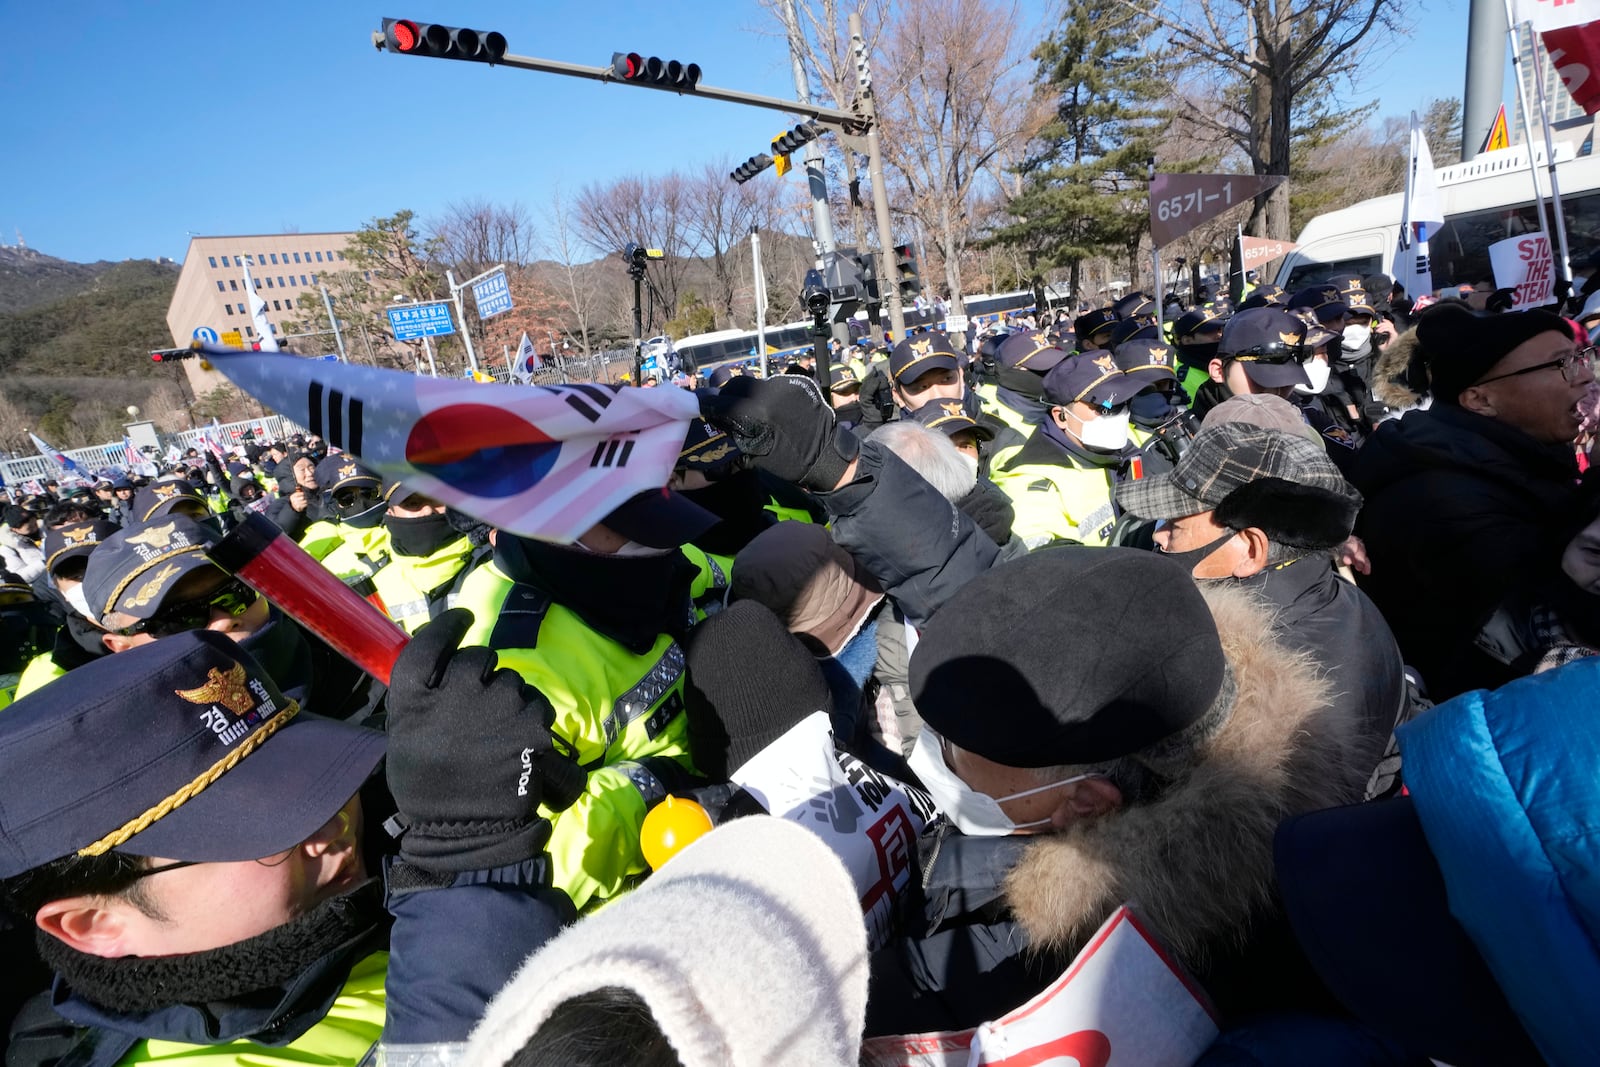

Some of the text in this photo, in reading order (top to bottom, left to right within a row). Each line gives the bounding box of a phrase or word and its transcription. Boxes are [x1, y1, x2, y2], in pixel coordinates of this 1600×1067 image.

[1158, 181, 1232, 221] 65기-1
[1245, 244, 1283, 259] 65기-3
[1517, 237, 1551, 261] STO
[1526, 259, 1552, 282] THE
